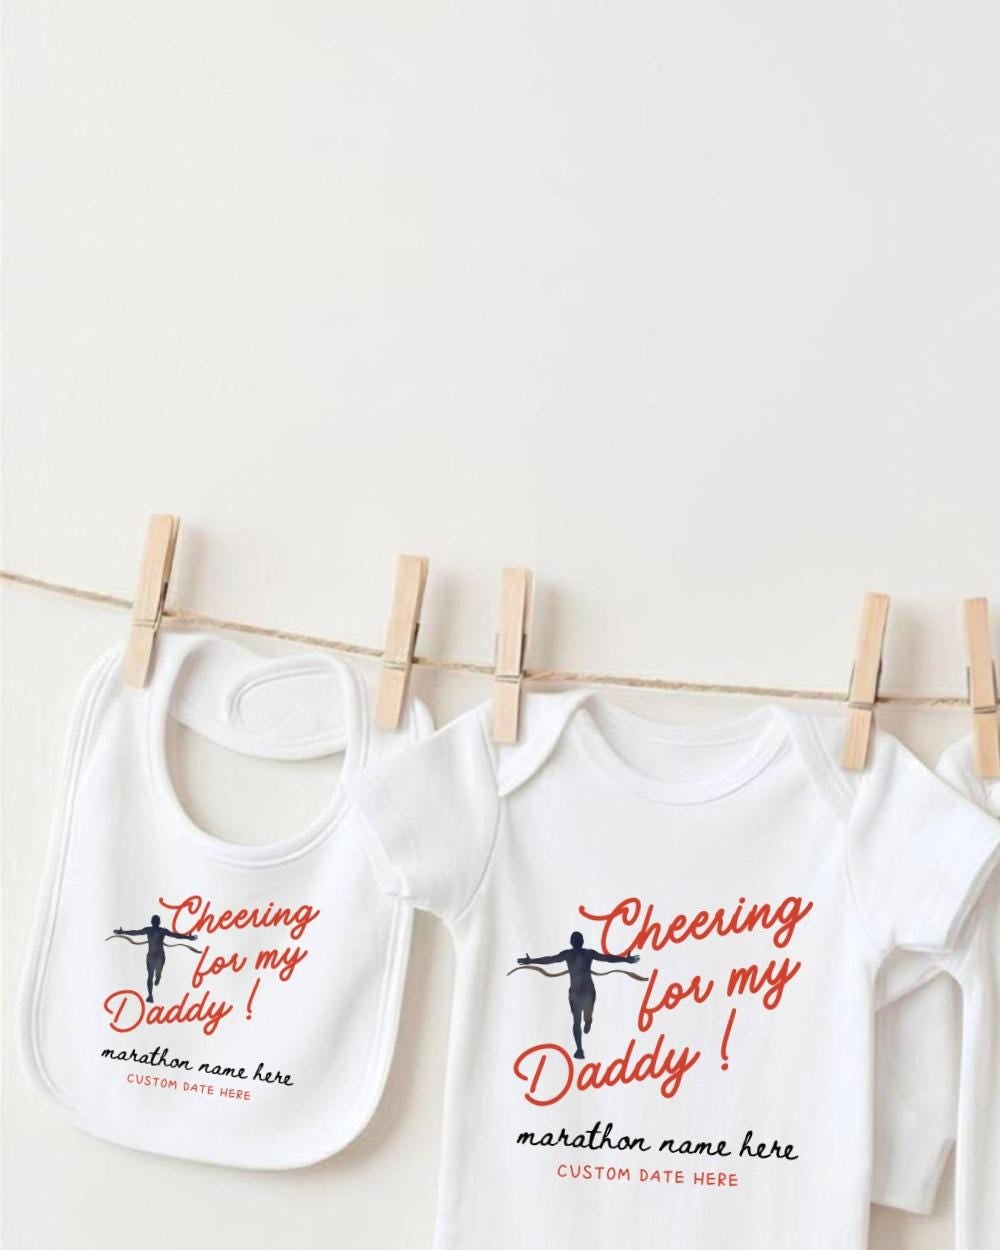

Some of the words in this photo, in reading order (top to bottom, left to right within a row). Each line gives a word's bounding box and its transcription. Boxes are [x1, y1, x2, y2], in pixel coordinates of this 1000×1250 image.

[159, 895, 321, 941] Cheering
[577, 895, 814, 959] Cheering
[191, 945, 248, 989] for
[254, 946, 308, 982] my
[103, 988, 233, 1037] Daddy
[637, 968, 715, 1033] for
[726, 957, 802, 1010] my
[101, 1046, 193, 1071] marathon
[198, 1062, 249, 1080] name
[252, 1062, 295, 1087] here
[127, 1072, 178, 1090] CUSTOM
[183, 1083, 214, 1096] DATE
[219, 1088, 251, 1101] HERE
[512, 1033, 702, 1108] Daddy
[515, 1120, 652, 1151] marathon
[658, 1139, 732, 1158] name
[738, 1130, 800, 1161] here
[556, 1164, 631, 1181] CUSTOM
[639, 1169, 684, 1184] DATE
[693, 1172, 739, 1187] HERE
